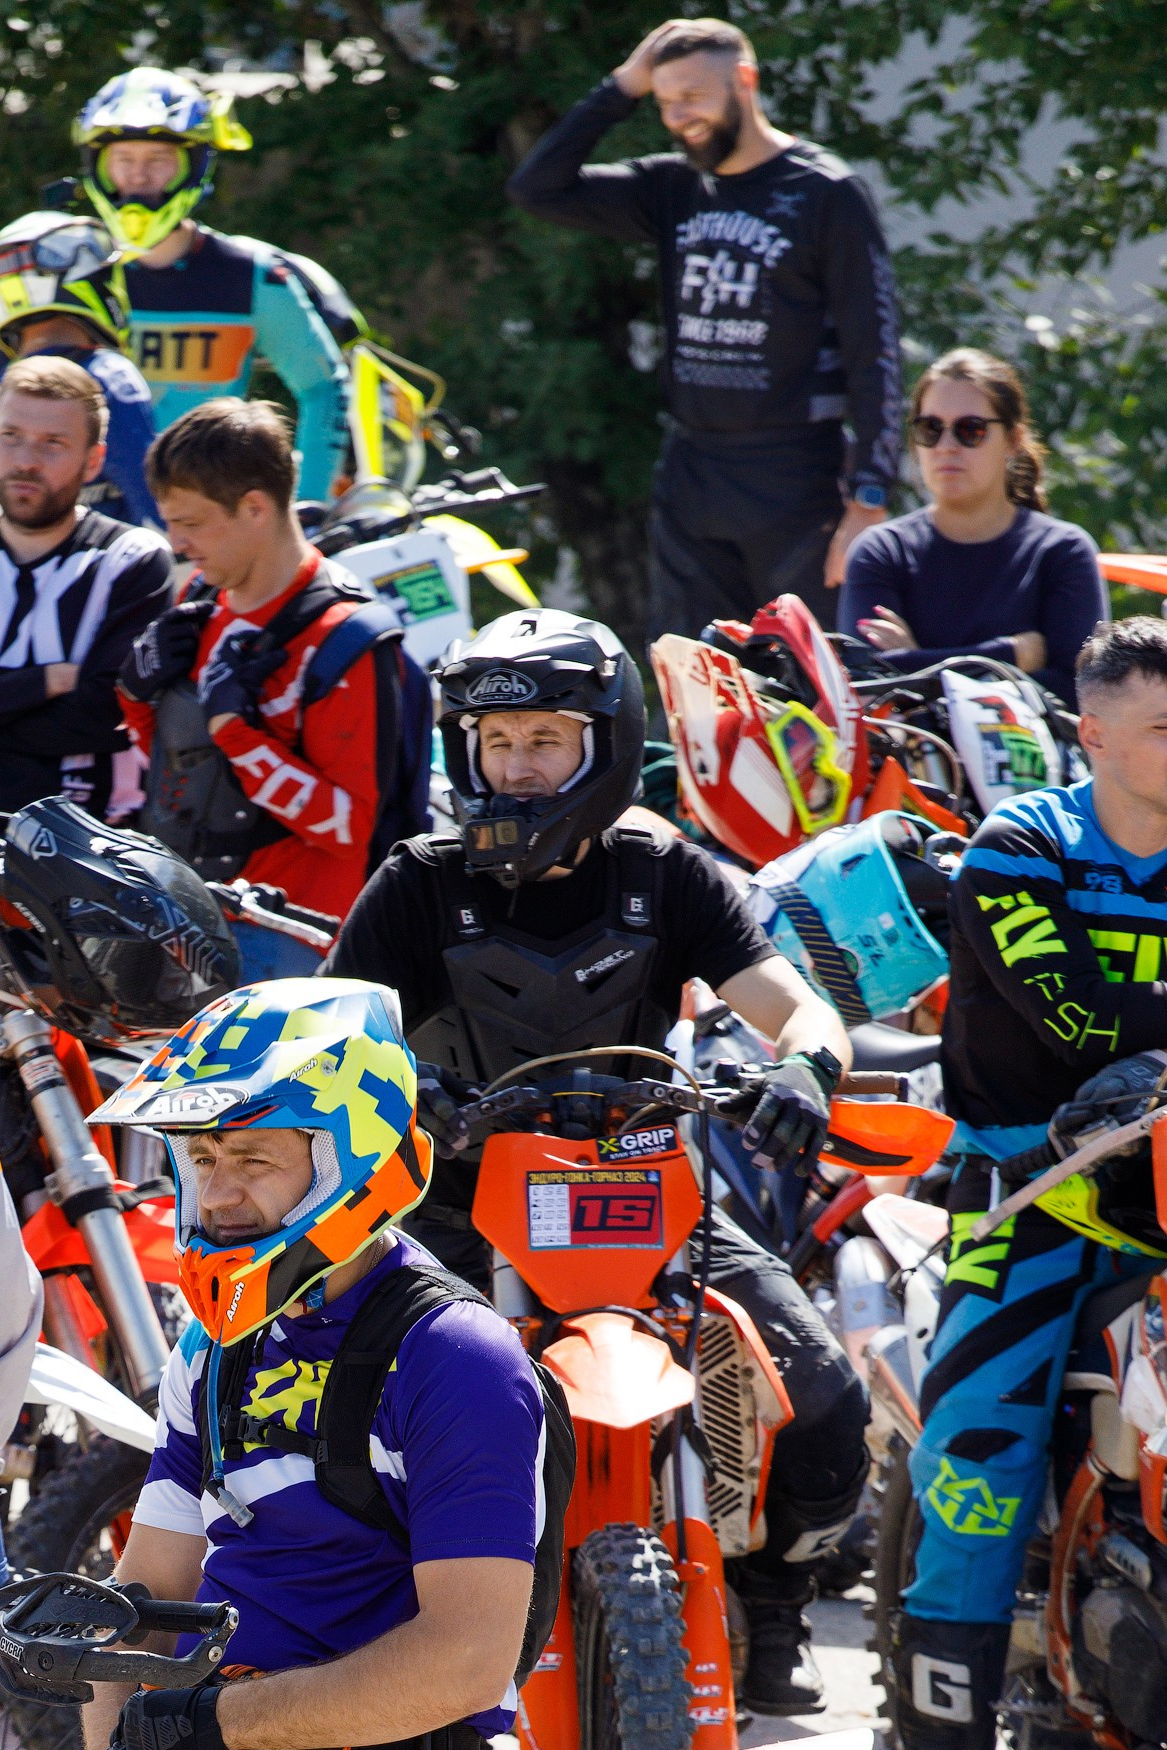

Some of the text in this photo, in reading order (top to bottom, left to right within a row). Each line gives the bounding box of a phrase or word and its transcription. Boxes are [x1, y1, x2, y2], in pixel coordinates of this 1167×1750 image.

[138, 331, 221, 370] ATT
[470, 674, 528, 697] Airoh
[228, 745, 352, 844] FOX
[289, 1058, 318, 1082] Airoh
[148, 1089, 238, 1117] Airoh
[597, 1128, 674, 1154] X-GRIP
[572, 1195, 656, 1231] 15
[225, 1281, 245, 1323] Airoh
